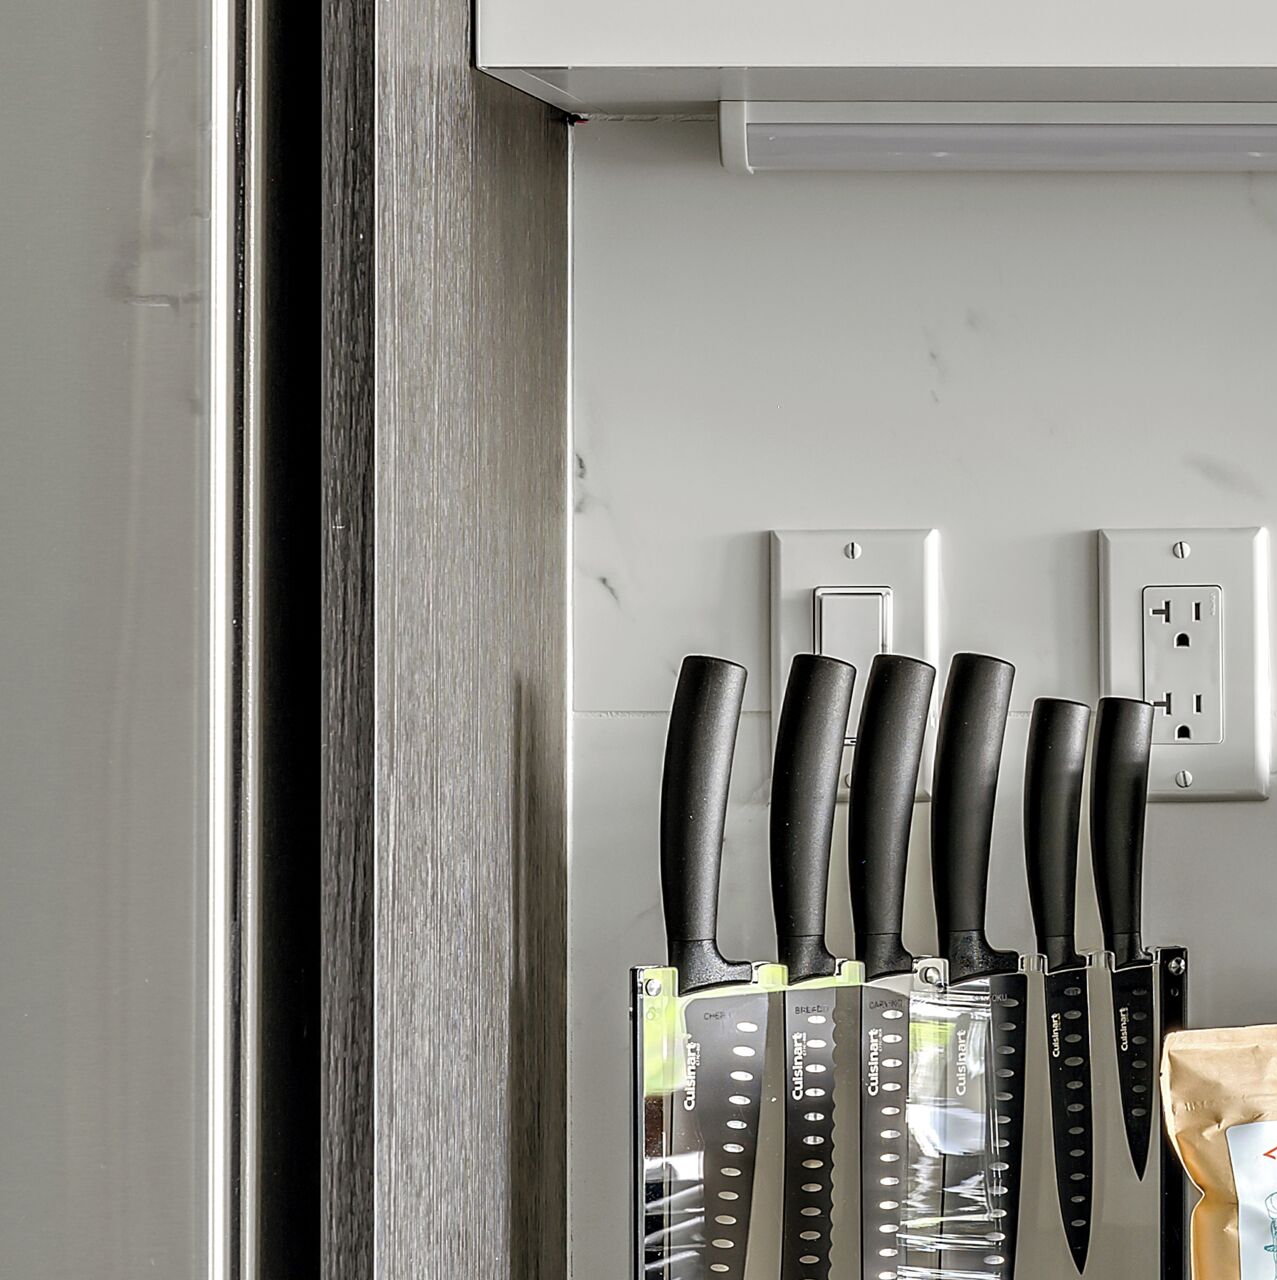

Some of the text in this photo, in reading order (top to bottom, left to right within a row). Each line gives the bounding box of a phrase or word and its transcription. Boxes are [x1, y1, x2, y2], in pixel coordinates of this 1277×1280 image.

[868, 1028, 879, 1096] Cuisinart
[956, 1029, 967, 1095] Cuisinart
[1051, 1013, 1060, 1057] Cuisinart
[1119, 1007, 1128, 1051] Cuisinart
[684, 1041, 696, 1111] Cuisinart
[792, 1031, 803, 1100] Cuisinart
